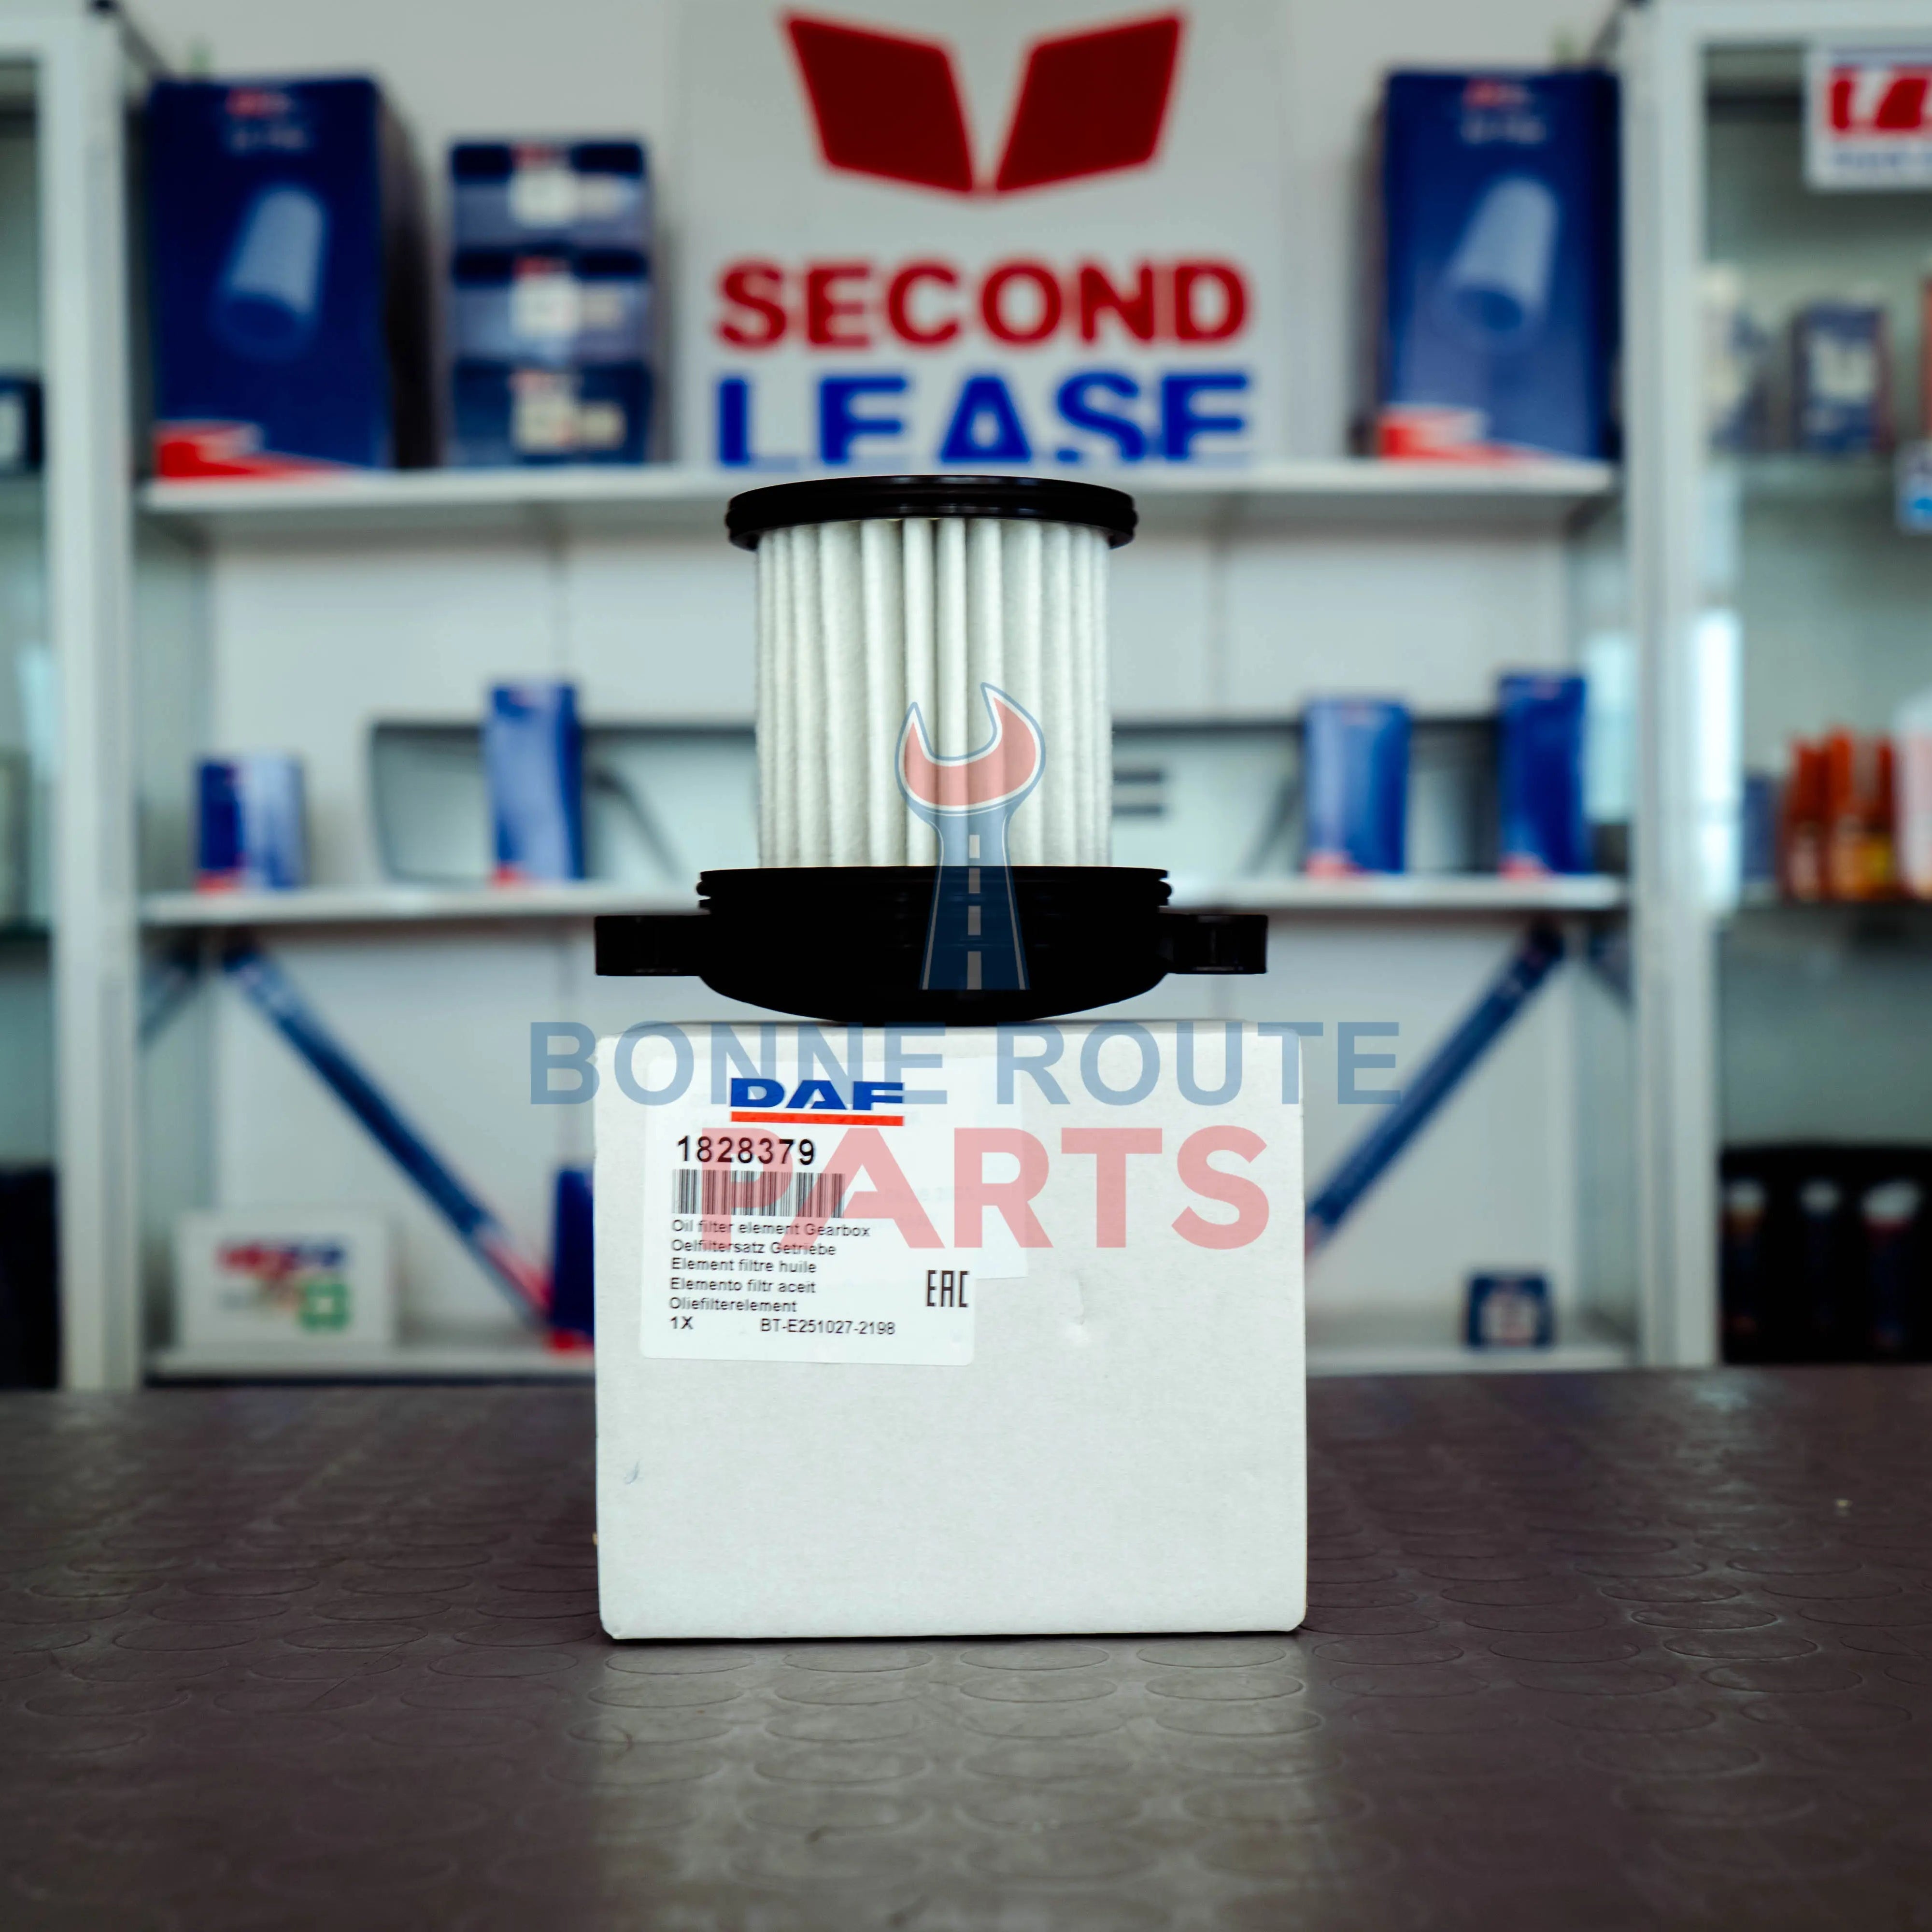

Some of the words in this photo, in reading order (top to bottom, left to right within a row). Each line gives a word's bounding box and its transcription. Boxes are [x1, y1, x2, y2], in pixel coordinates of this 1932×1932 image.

[716, 257, 1250, 351] SECOND
[716, 371, 1250, 467] LEASE
[730, 1078, 905, 1110] DAF
[677, 1136, 815, 1165] 1828379
[672, 1219, 694, 1232] Oil
[697, 1220, 733, 1233] filter
[738, 1221, 801, 1235] element
[805, 1223, 870, 1236] Gearbox
[671, 1239, 765, 1254] Oelfiltersatz
[770, 1241, 837, 1255] Getriebe
[671, 1257, 735, 1271] Element
[739, 1259, 773, 1272] filtre
[779, 1260, 817, 1273] huile
[670, 1277, 742, 1291] Elemento
[747, 1279, 773, 1292] filtr
[778, 1281, 816, 1293] aceit
[926, 1270, 969, 1307] EAC
[669, 1296, 797, 1312] Oliefilterelement
[670, 1316, 694, 1329] 1X
[760, 1319, 896, 1335] BT-E251027-2198
